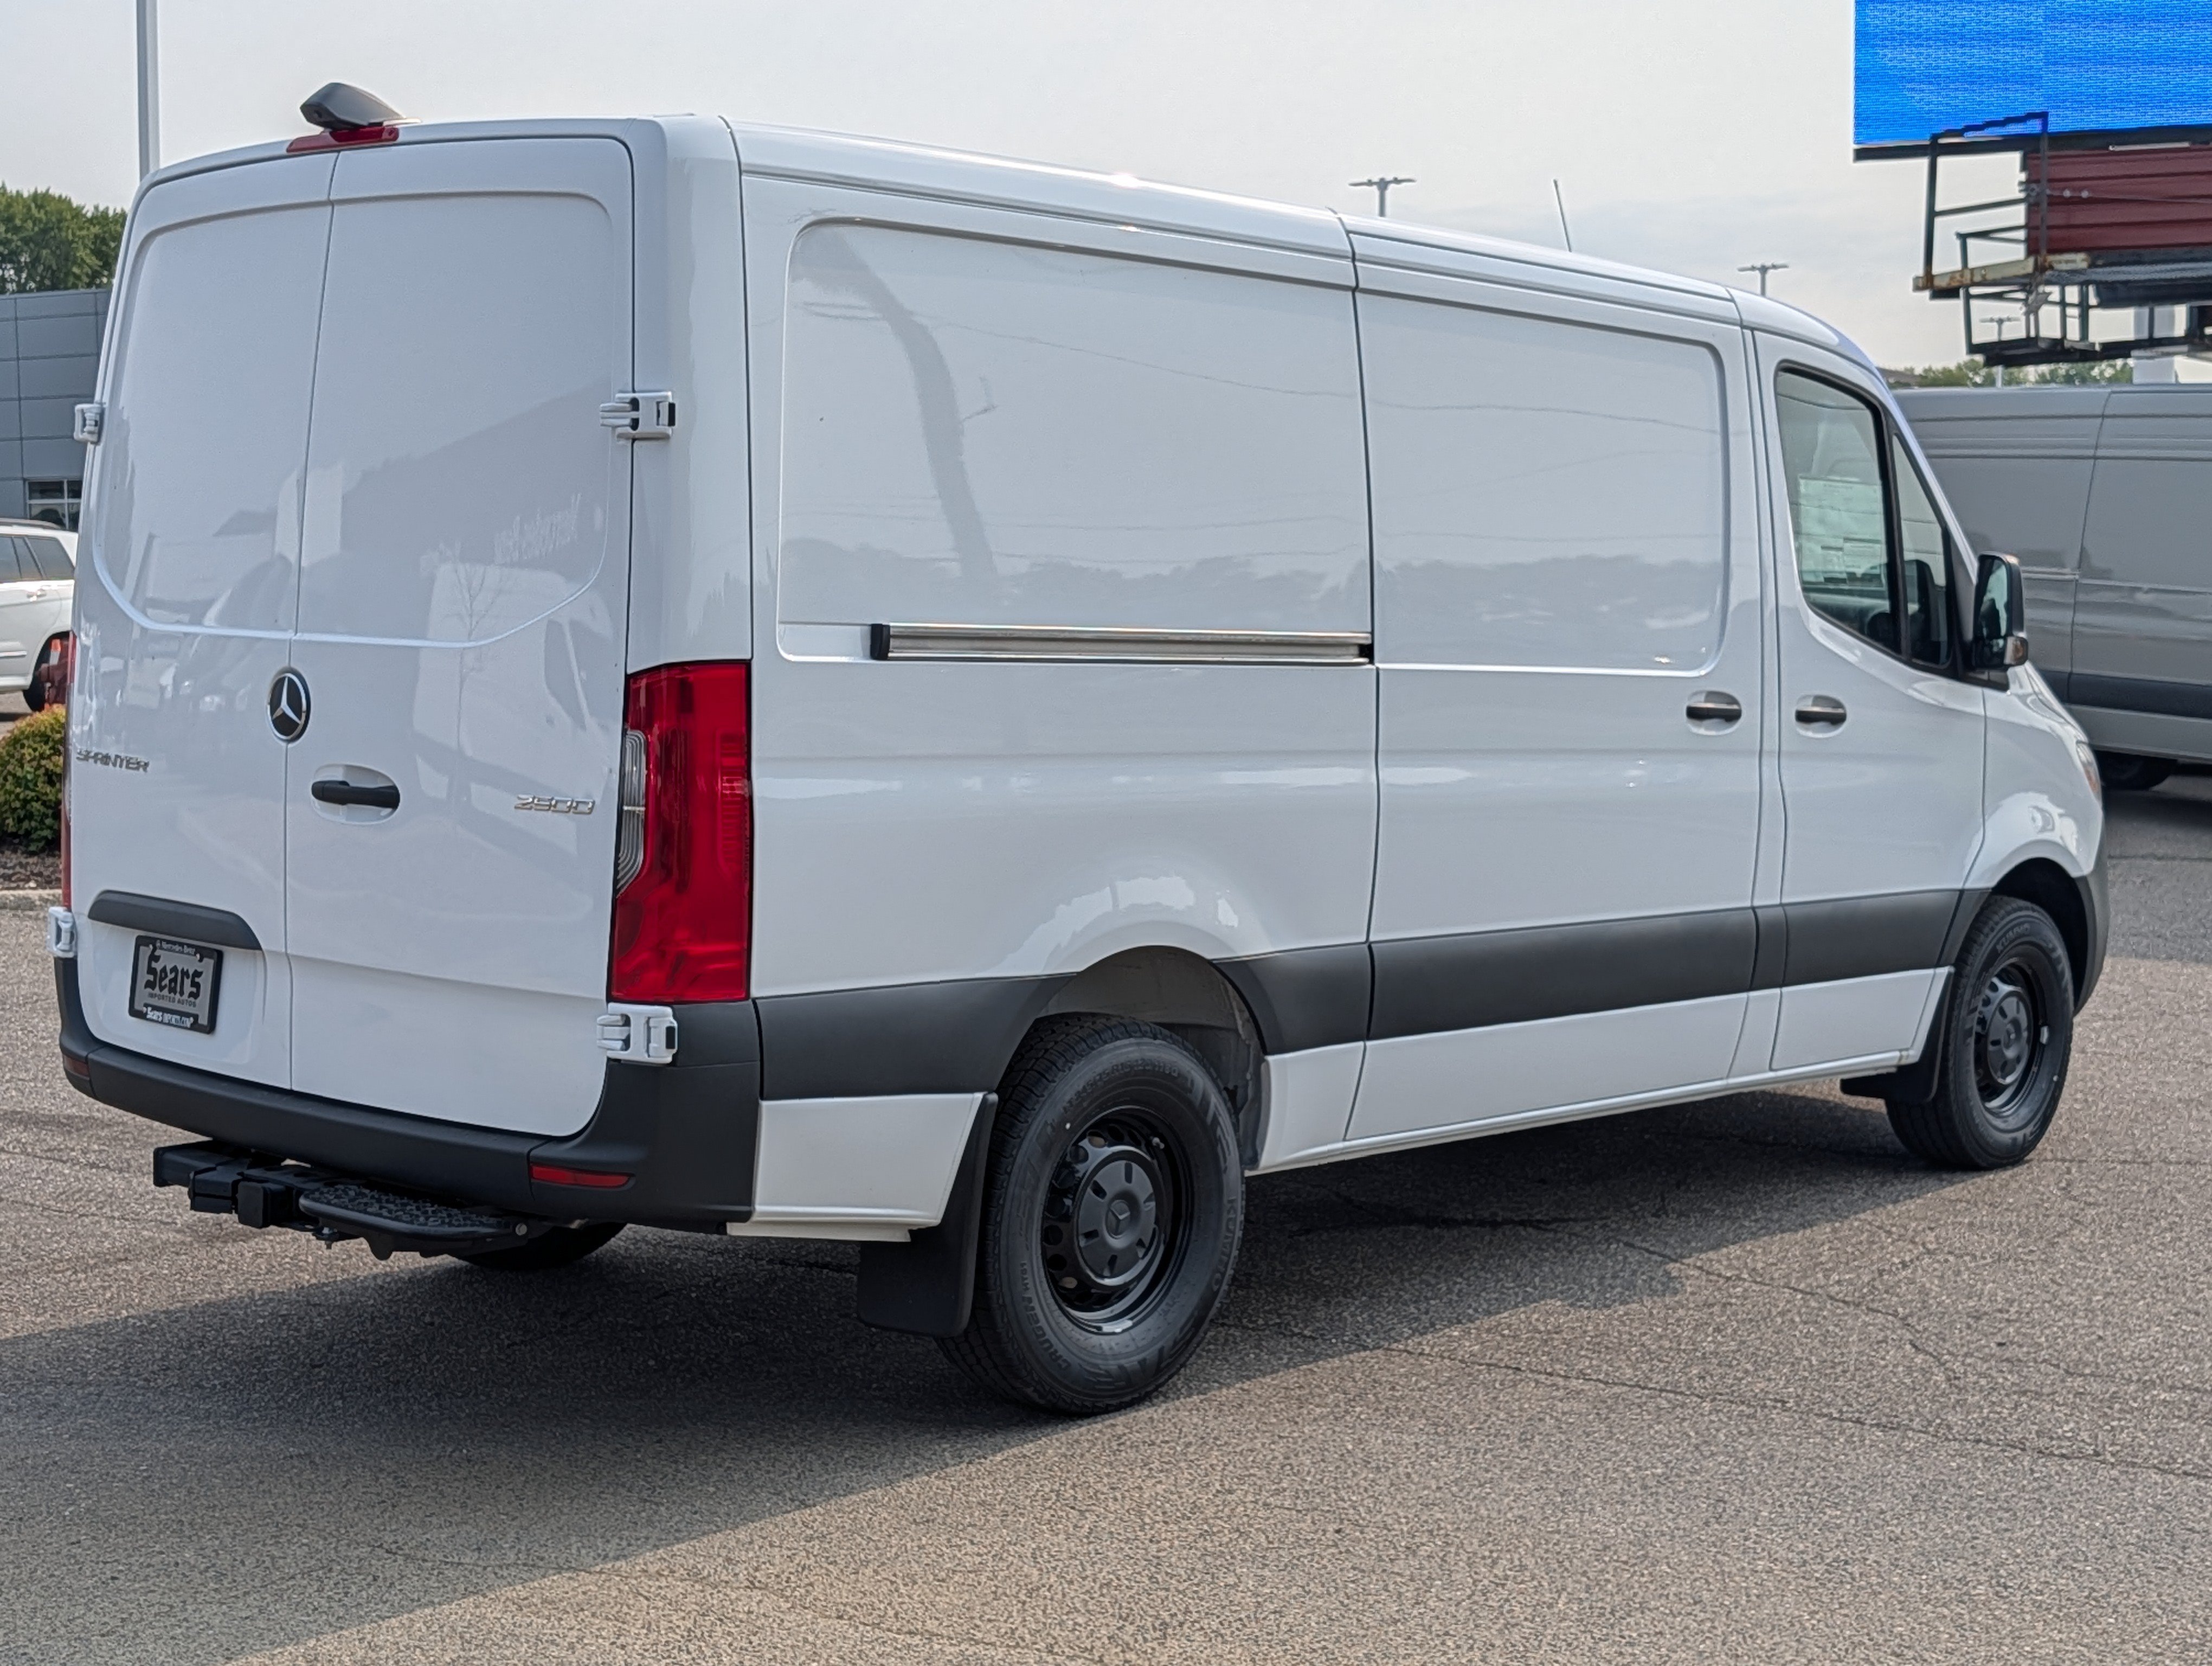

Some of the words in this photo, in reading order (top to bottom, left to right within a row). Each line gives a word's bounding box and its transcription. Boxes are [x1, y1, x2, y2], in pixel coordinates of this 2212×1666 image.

[76, 749, 150, 772] SPRINTER
[515, 794, 596, 815] 2500
[144, 953, 203, 999] Sears
[148, 992, 176, 1003] IMPORTED
[177, 998, 196, 1008] AUTOS
